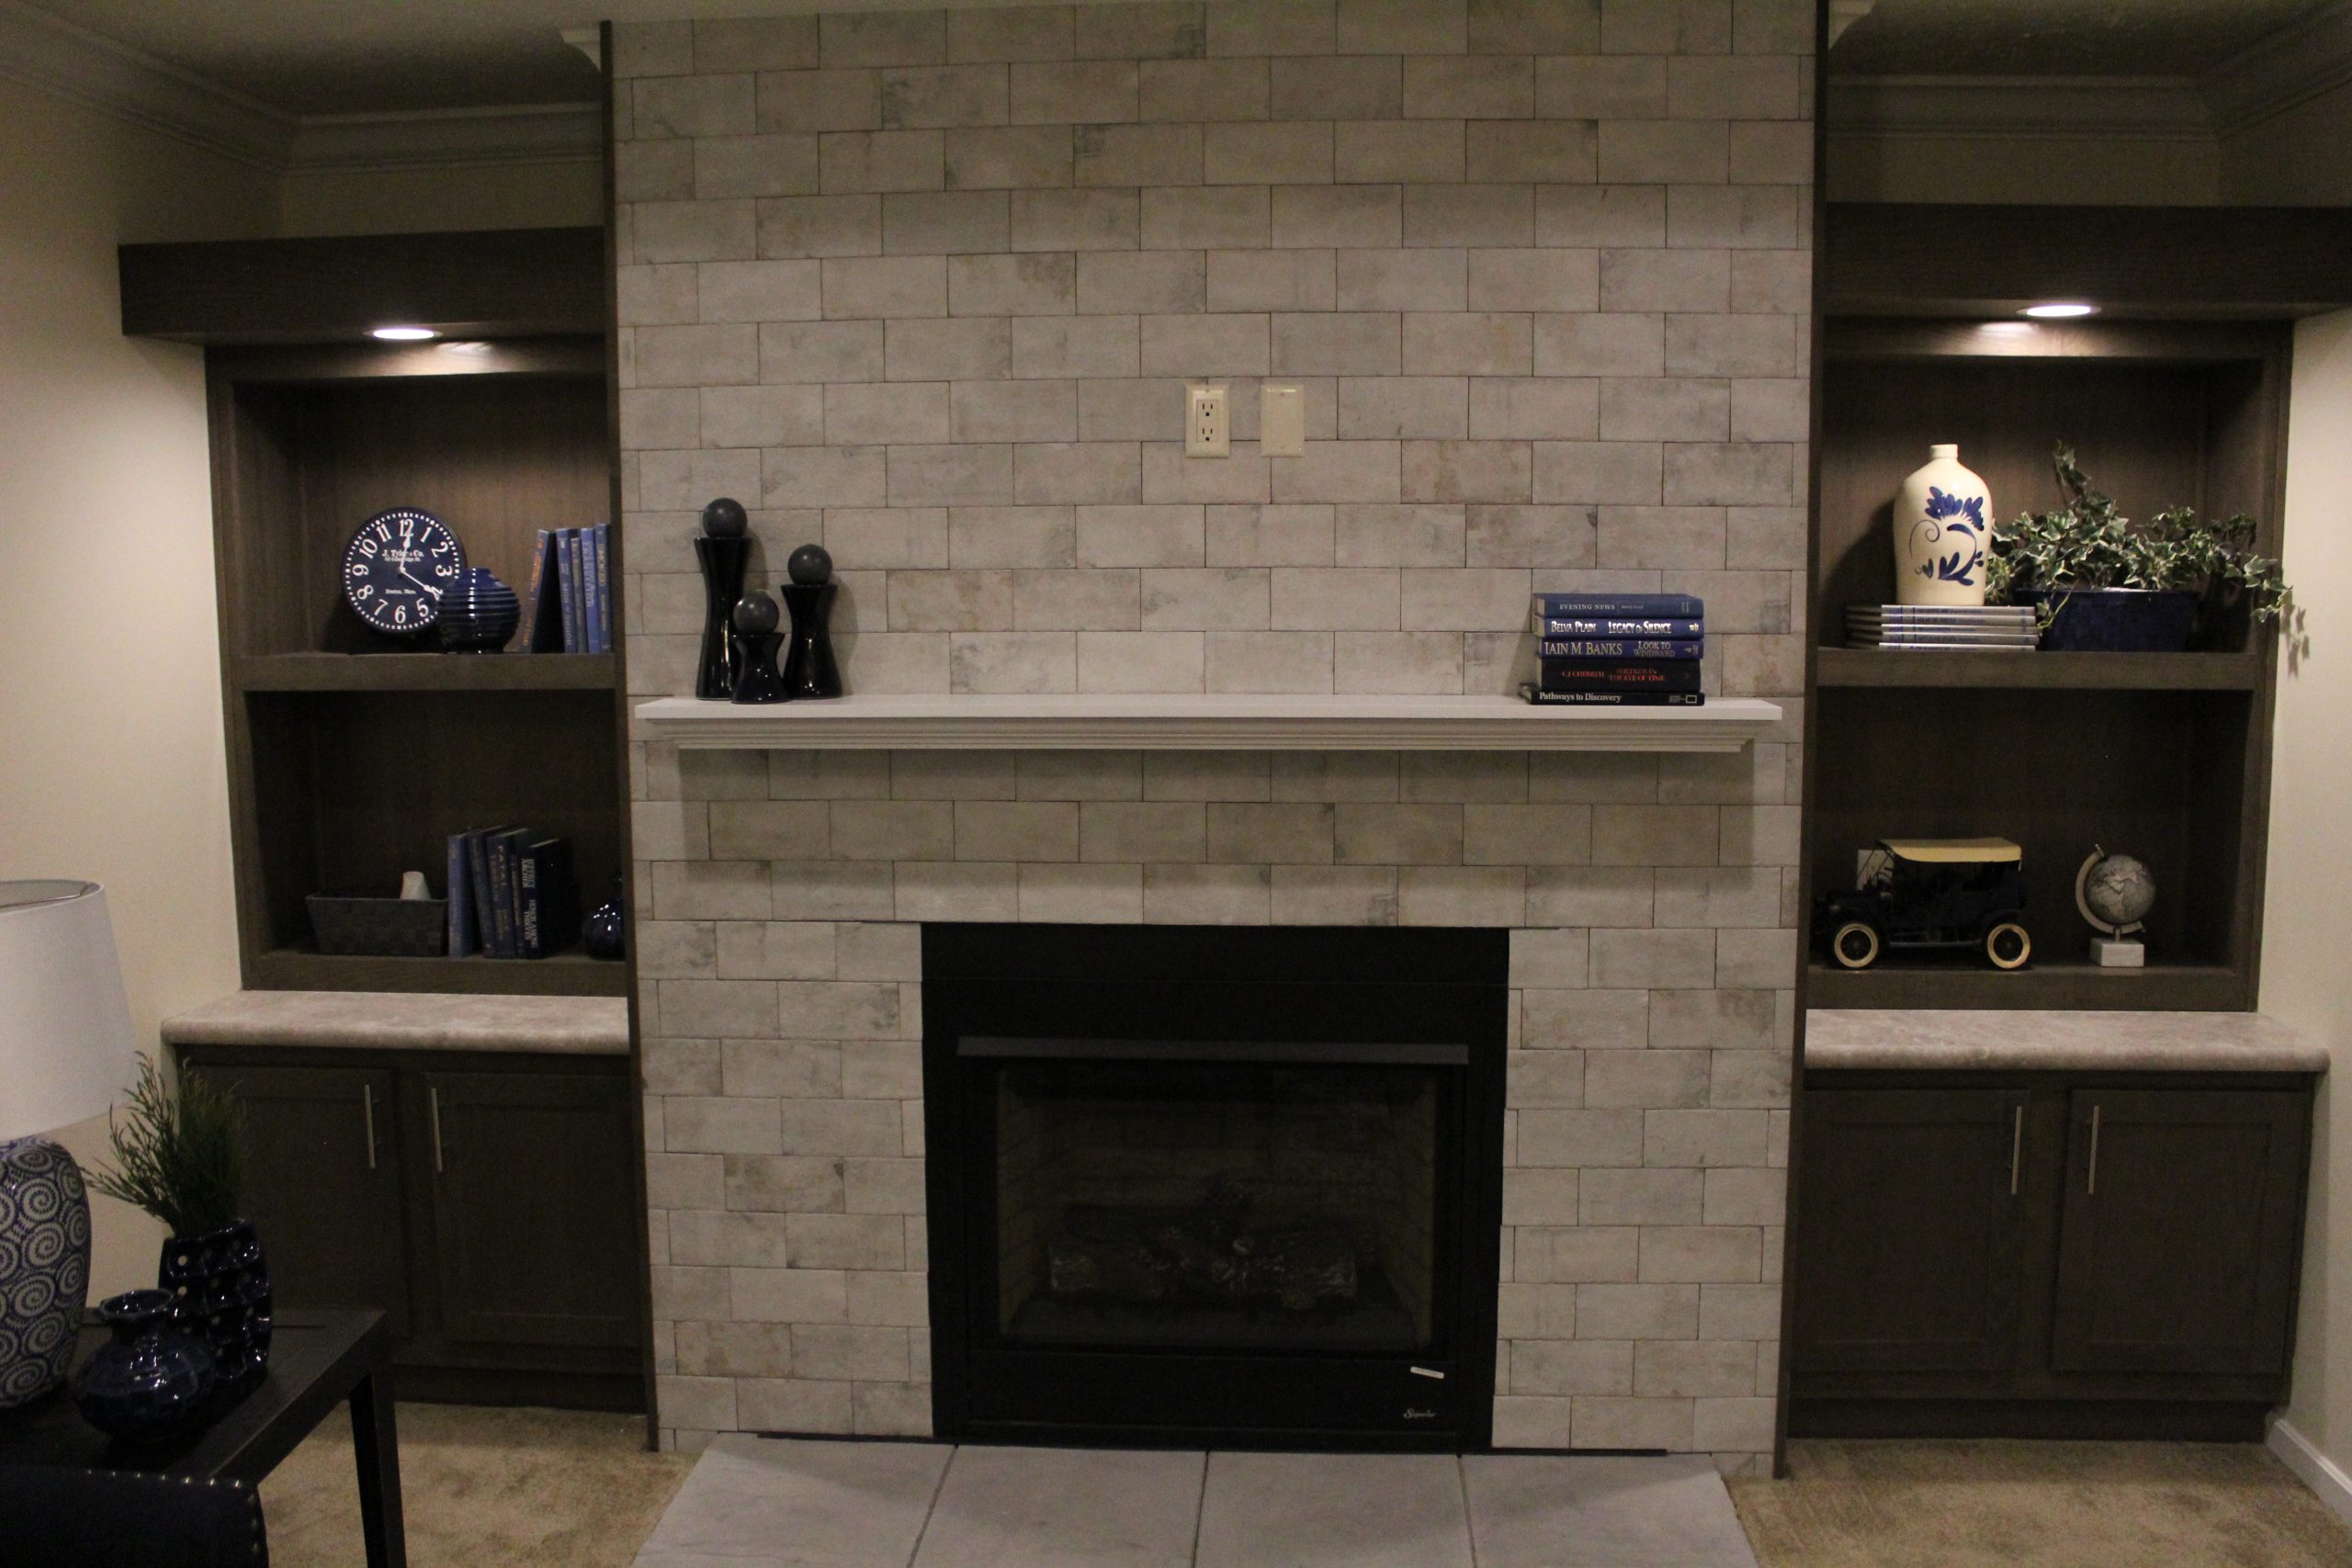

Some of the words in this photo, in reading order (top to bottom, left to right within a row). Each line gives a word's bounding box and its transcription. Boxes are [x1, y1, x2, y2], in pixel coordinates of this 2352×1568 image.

[376, 523, 392, 543] 11
[399, 518, 414, 537] 12
[420, 526, 433, 544] 1
[358, 538, 378, 559] 10
[430, 541, 449, 558] 2
[352, 564, 369, 577] 9
[435, 564, 453, 577] 3
[356, 584, 374, 600] 8
[374, 598, 389, 616] 7
[394, 605, 406, 624] 6
[416, 597, 429, 617] 5
[1551, 621, 1573, 633] BELVA
[1575, 621, 1597, 633] PLAIN
[1608, 621, 1634, 634] LEGACY
[1643, 621, 1672, 634] SILENCE
[1544, 642, 1568, 655] IAIN
[1586, 642, 1623, 655] BANKS
[1633, 649, 1675, 658] WINDWARD
[1638, 641, 1659, 650] LOOK
[1660, 641, 1671, 650] TO
[1539, 692, 1575, 703] Pathways
[1585, 693, 1622, 704] Discovery
